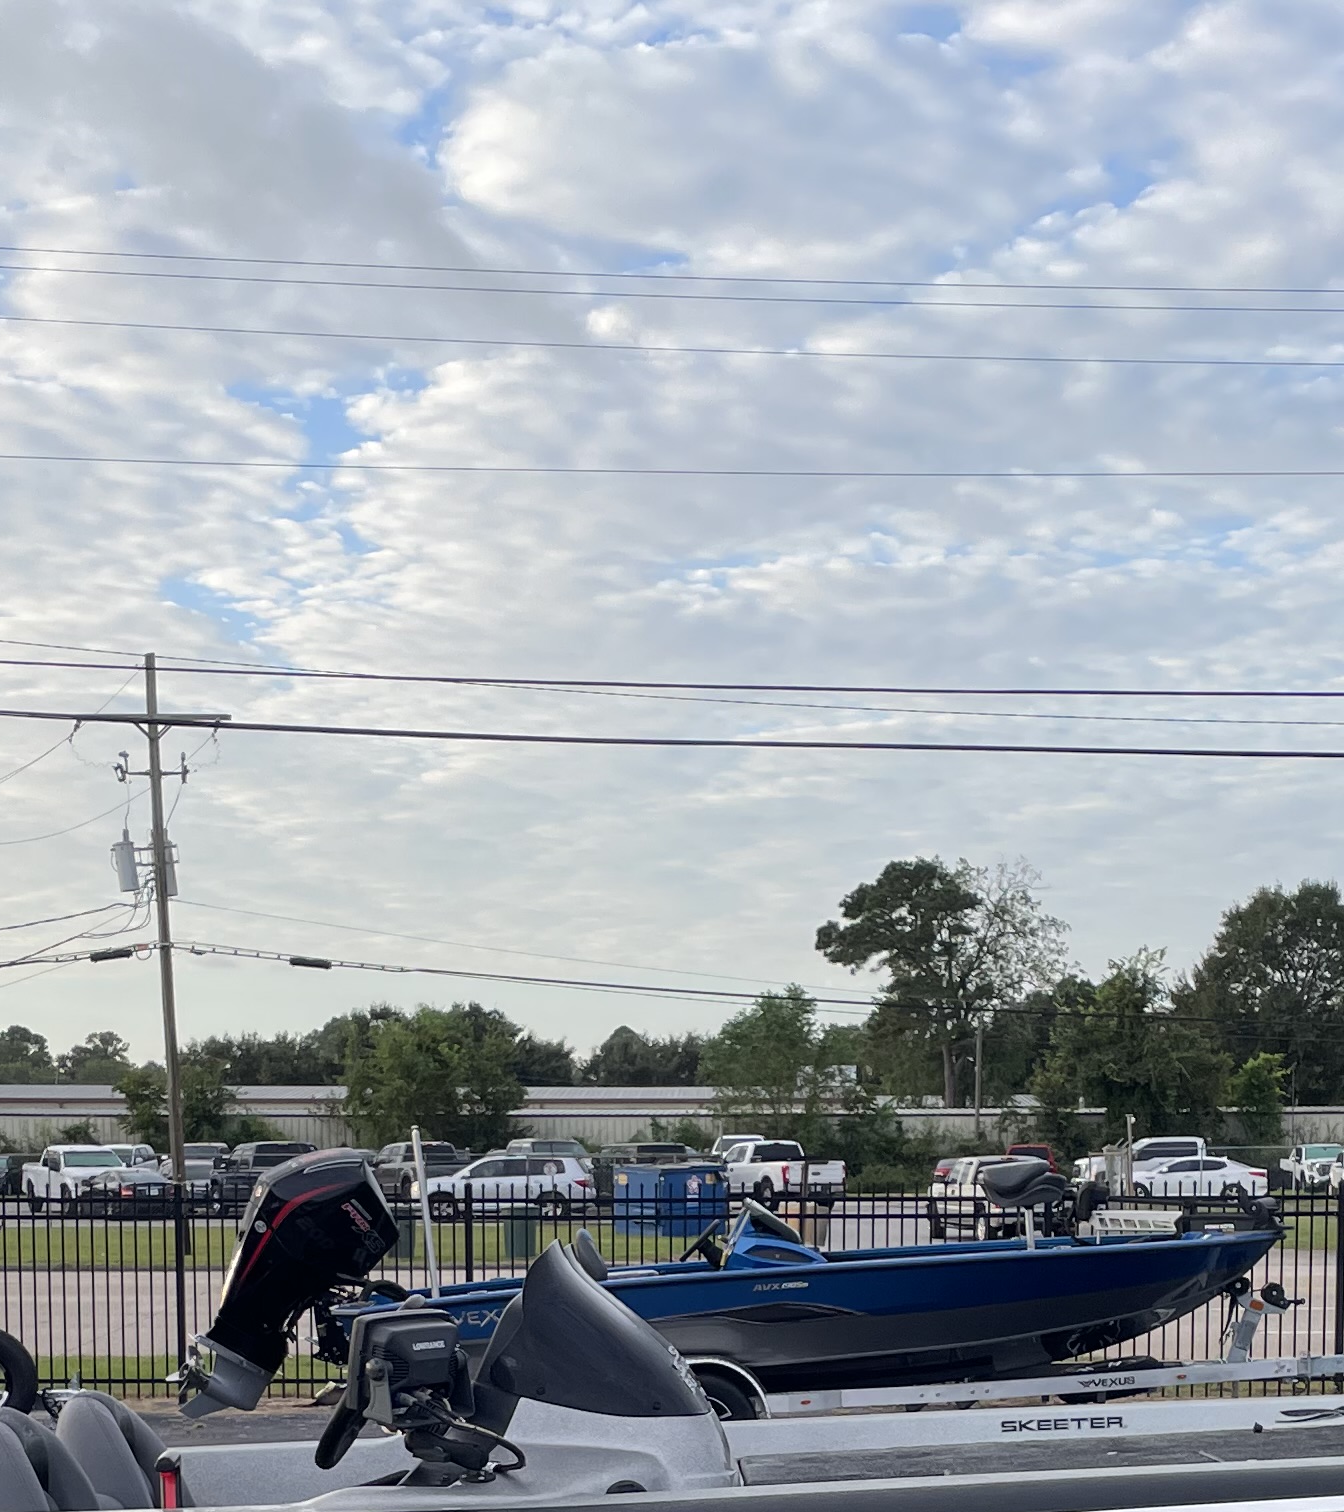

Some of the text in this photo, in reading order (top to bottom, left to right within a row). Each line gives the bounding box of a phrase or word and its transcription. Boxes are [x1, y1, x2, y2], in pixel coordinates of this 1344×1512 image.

[449, 1307, 506, 1328] VEX
[1091, 1375, 1136, 1388] VEXUS
[1000, 1416, 1125, 1433] SKEETER
